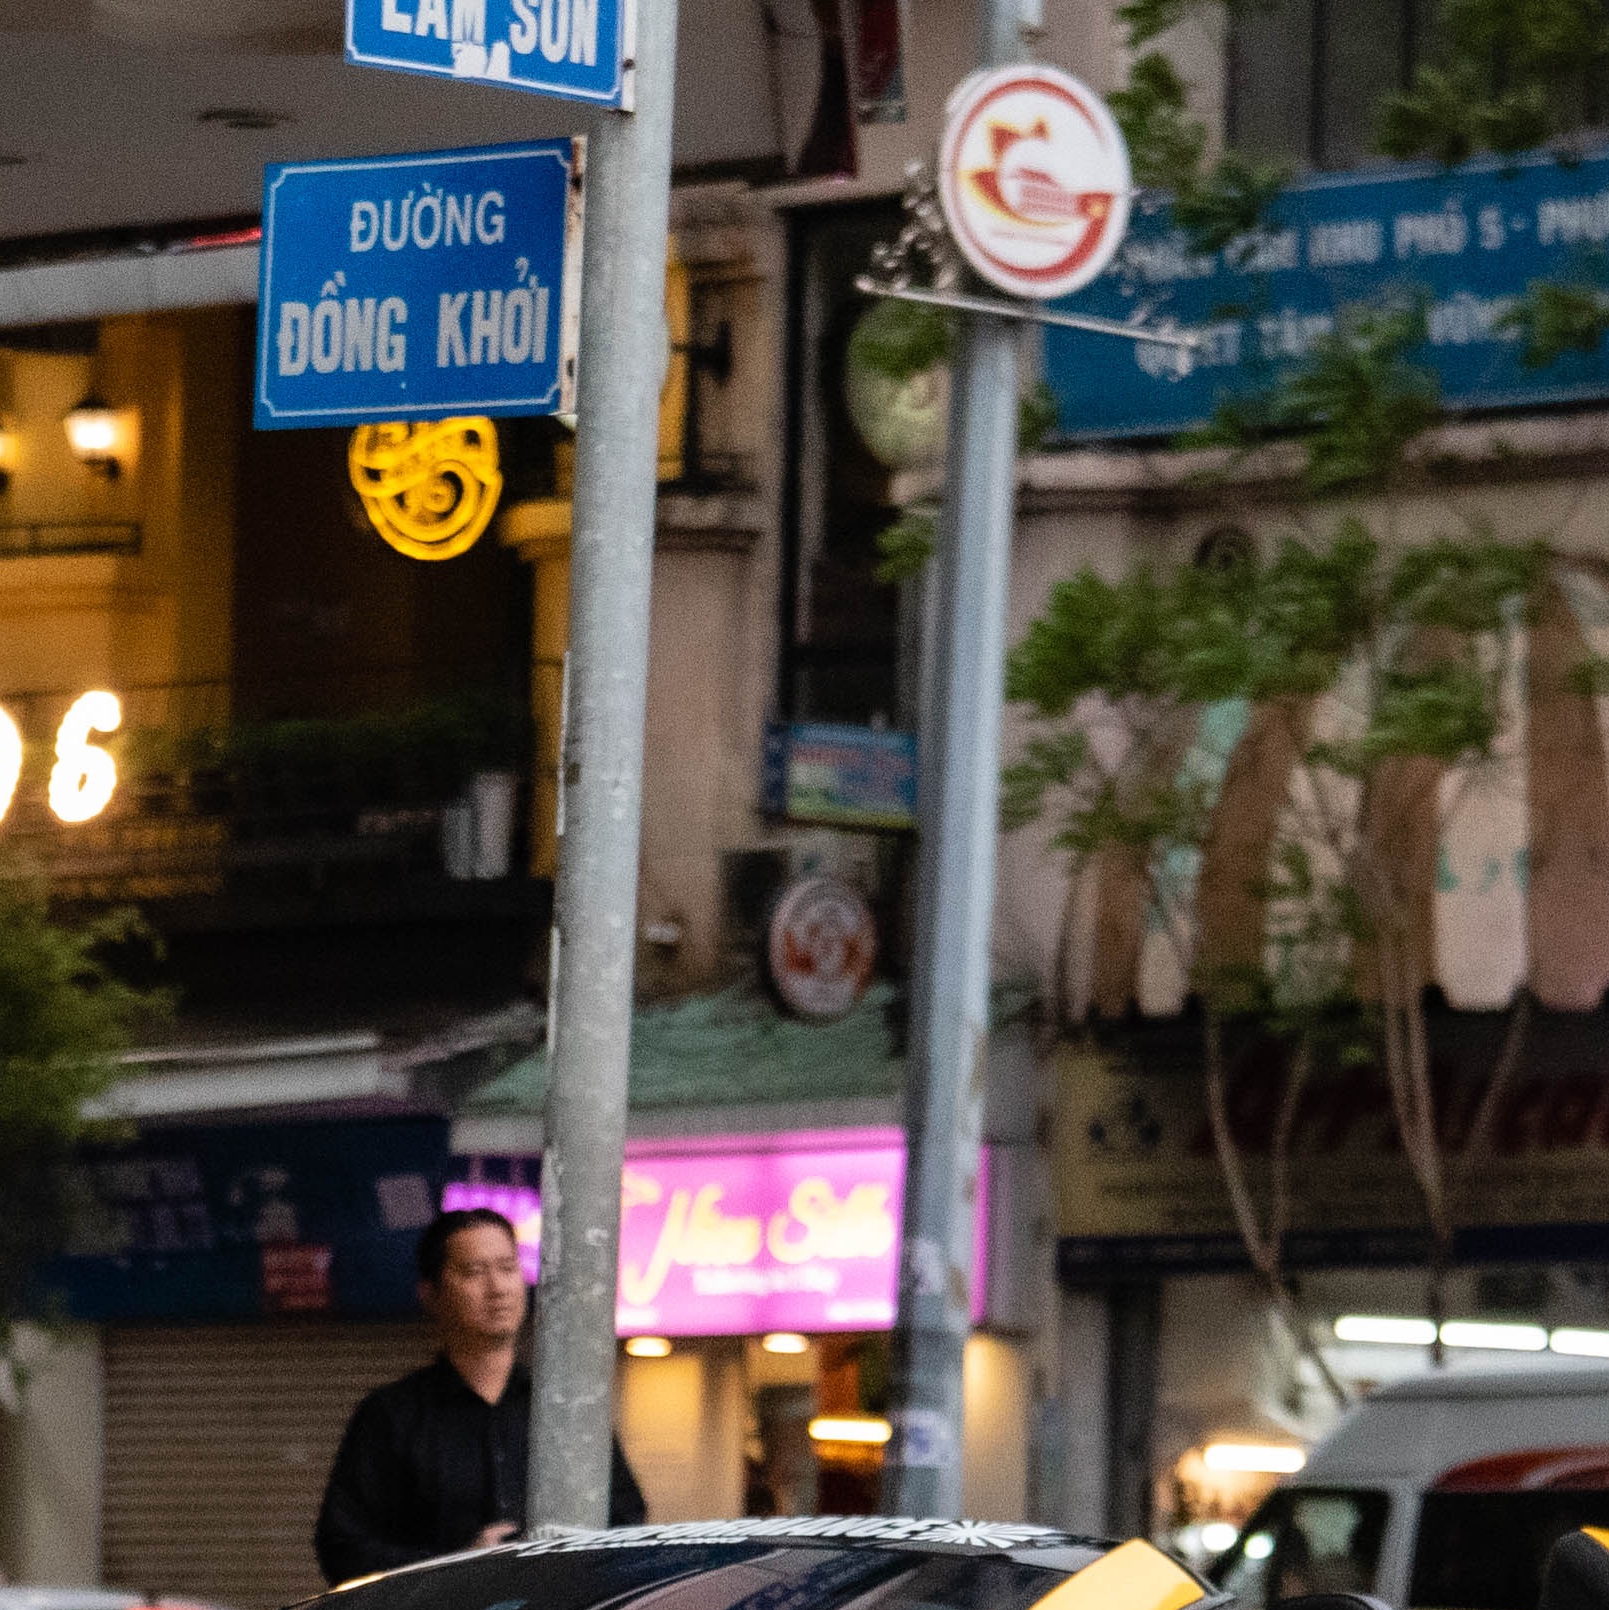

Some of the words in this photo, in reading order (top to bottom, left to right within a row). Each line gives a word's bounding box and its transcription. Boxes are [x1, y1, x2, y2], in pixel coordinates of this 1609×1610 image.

[350, 181, 507, 253] ĐƯỜNG
[276, 270, 408, 377] ĐỒNG
[436, 256, 551, 369] KHỞI
